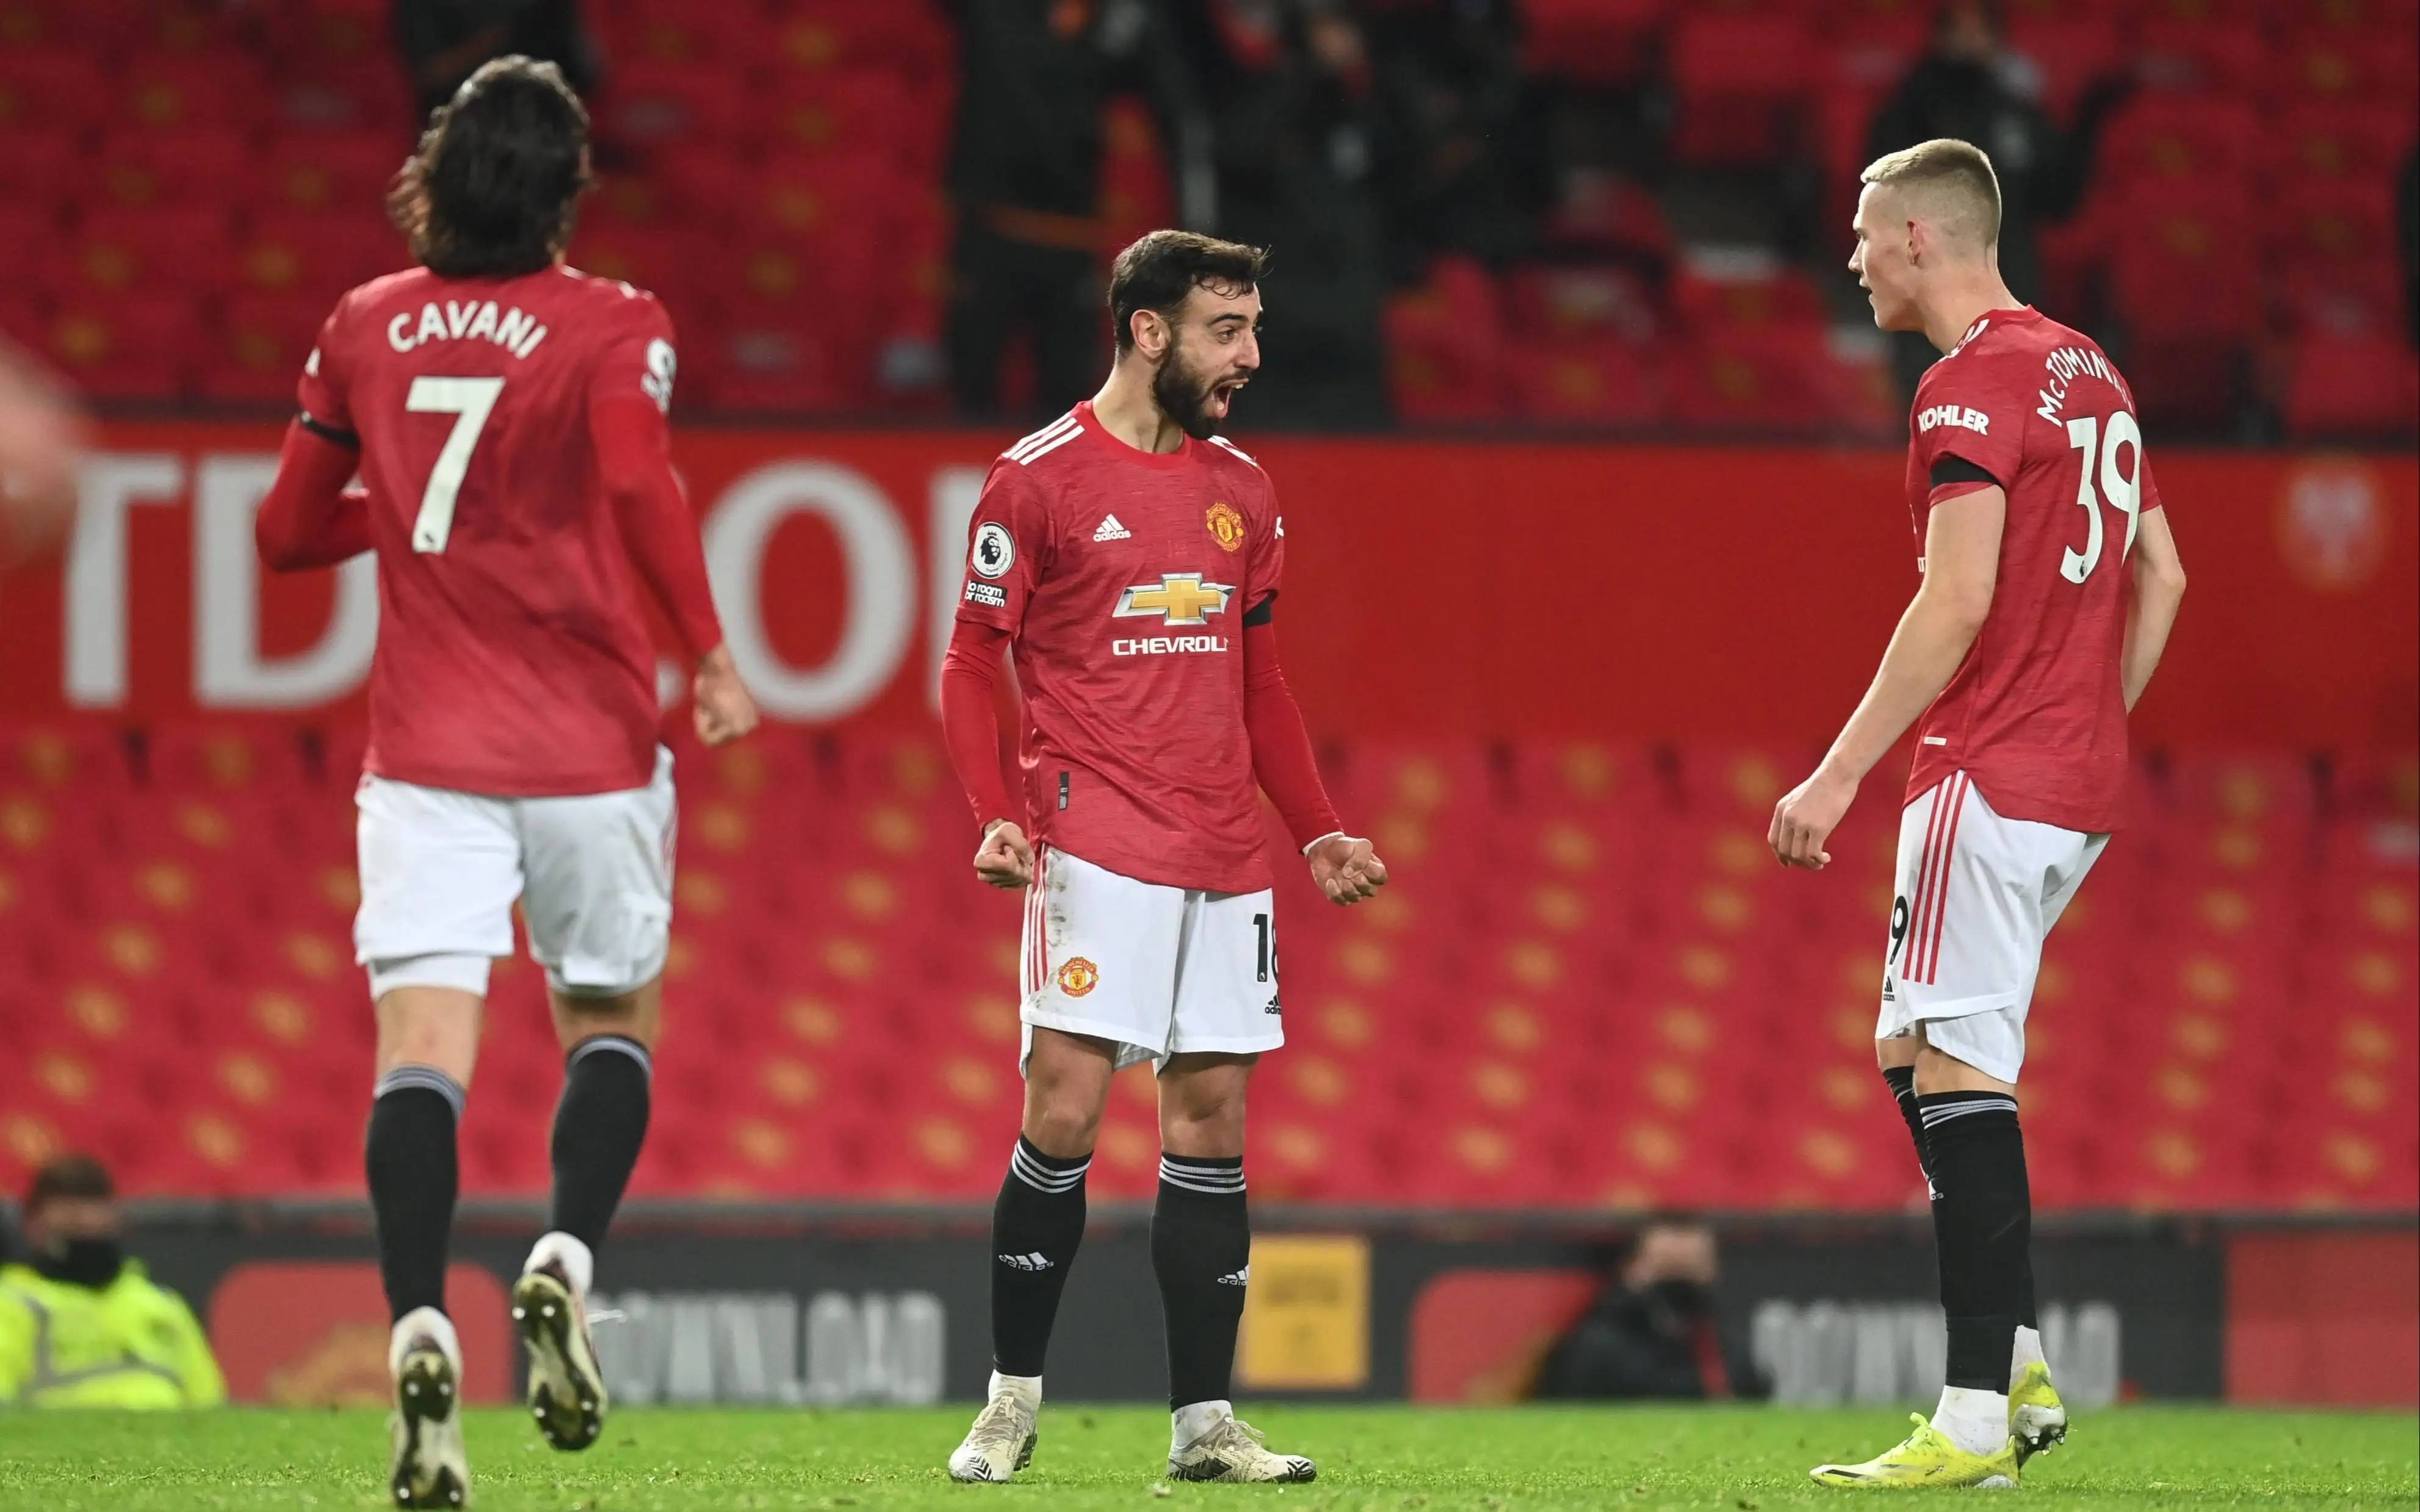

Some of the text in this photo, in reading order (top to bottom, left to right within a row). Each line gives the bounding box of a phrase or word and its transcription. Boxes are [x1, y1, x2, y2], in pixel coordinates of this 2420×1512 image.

[388, 300, 547, 360] CAVANI
[2037, 347, 2134, 428] McTOMIN
[1918, 405, 1990, 436] KOHLER
[406, 376, 506, 553] 7
[2060, 410, 2142, 585] 39
[1093, 530, 1132, 542] adidas
[977, 584, 1002, 597] room
[1113, 636, 1229, 656] CHEVROL
[1253, 913, 1279, 984] 1
[999, 1253, 1055, 1272] adidas
